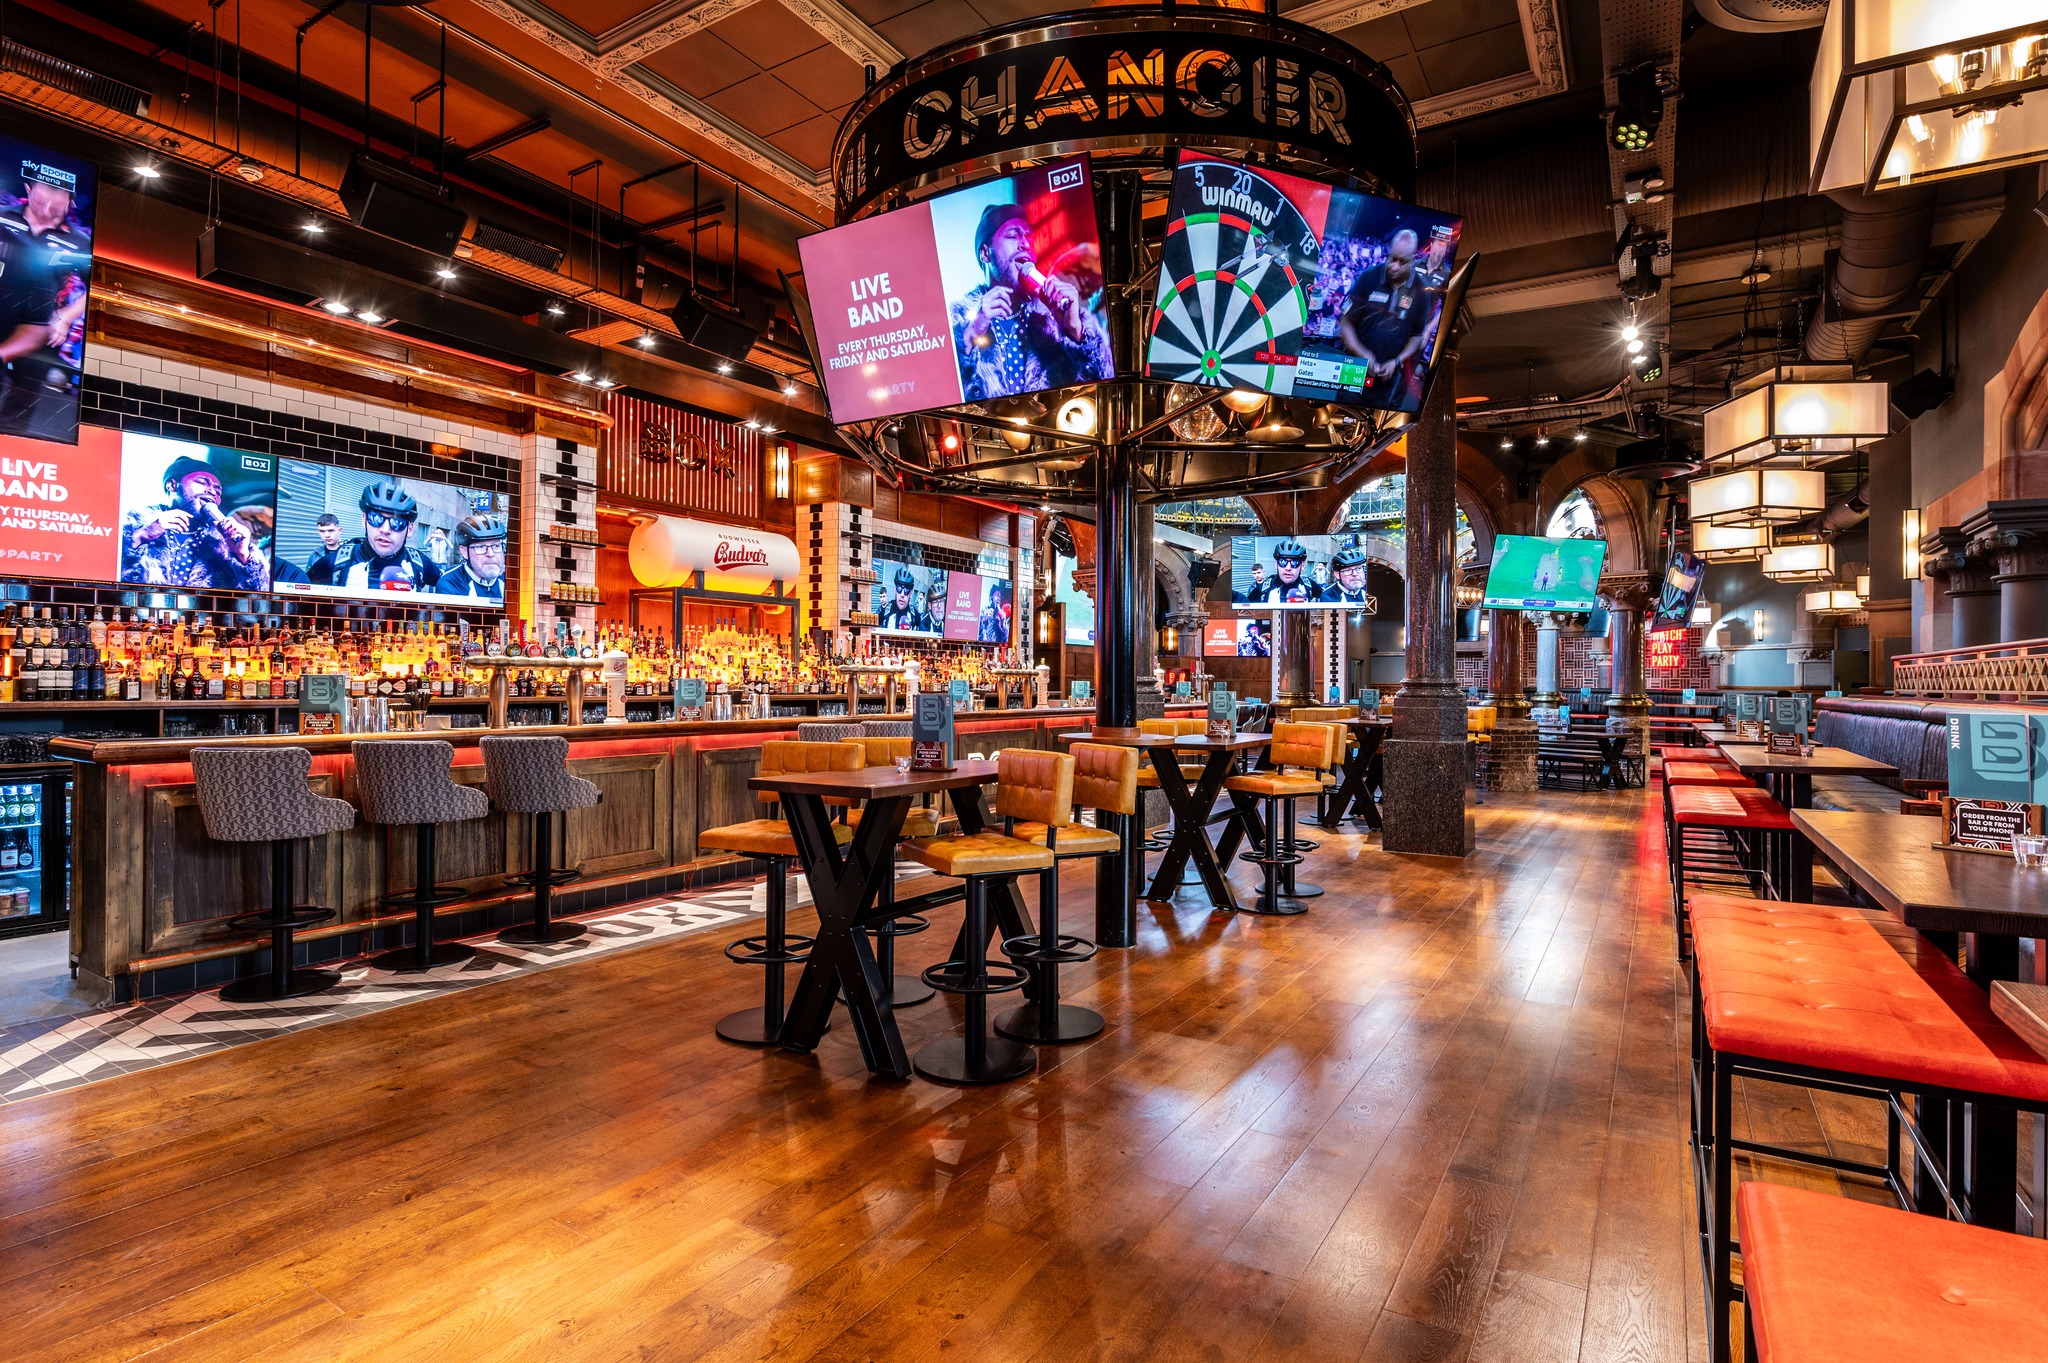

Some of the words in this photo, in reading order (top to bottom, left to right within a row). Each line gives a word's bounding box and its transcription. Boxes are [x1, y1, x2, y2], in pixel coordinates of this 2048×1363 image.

[903, 47, 1352, 159] CHANGER
[22, 160, 40, 171] sky
[42, 166, 74, 180] sports
[37, 174, 60, 185] arena
[1053, 171, 1078, 186] BOX
[1194, 166, 1204, 187] 5
[1231, 171, 1252, 195] 20
[1299, 231, 1316, 256] 18
[850, 272, 892, 301] LIVE
[847, 297, 904, 328] BAND
[838, 338, 868, 354] EVERY
[869, 325, 928, 348] THURSDAY,
[829, 352, 864, 370] FRIDAY
[866, 348, 890, 362] AND
[890, 335, 946, 358] SATURDAY
[640, 420, 736, 480] BOX
[2, 457, 58, 481] LIVE
[246, 459, 266, 469] BOX
[2, 517, 37, 530] AND
[38, 520, 113, 537] SATURDAY
[12, 507, 92, 526] THURSDAY,
[718, 533, 761, 544] BUDWEISER
[714, 541, 768, 568] Budvar
[956, 599, 971, 608] BAND
[959, 590, 970, 600] LIVE
[1652, 642, 1673, 654] PLAY
[1652, 656, 1679, 667] PARTY
[1950, 718, 1960, 750] DRINK
